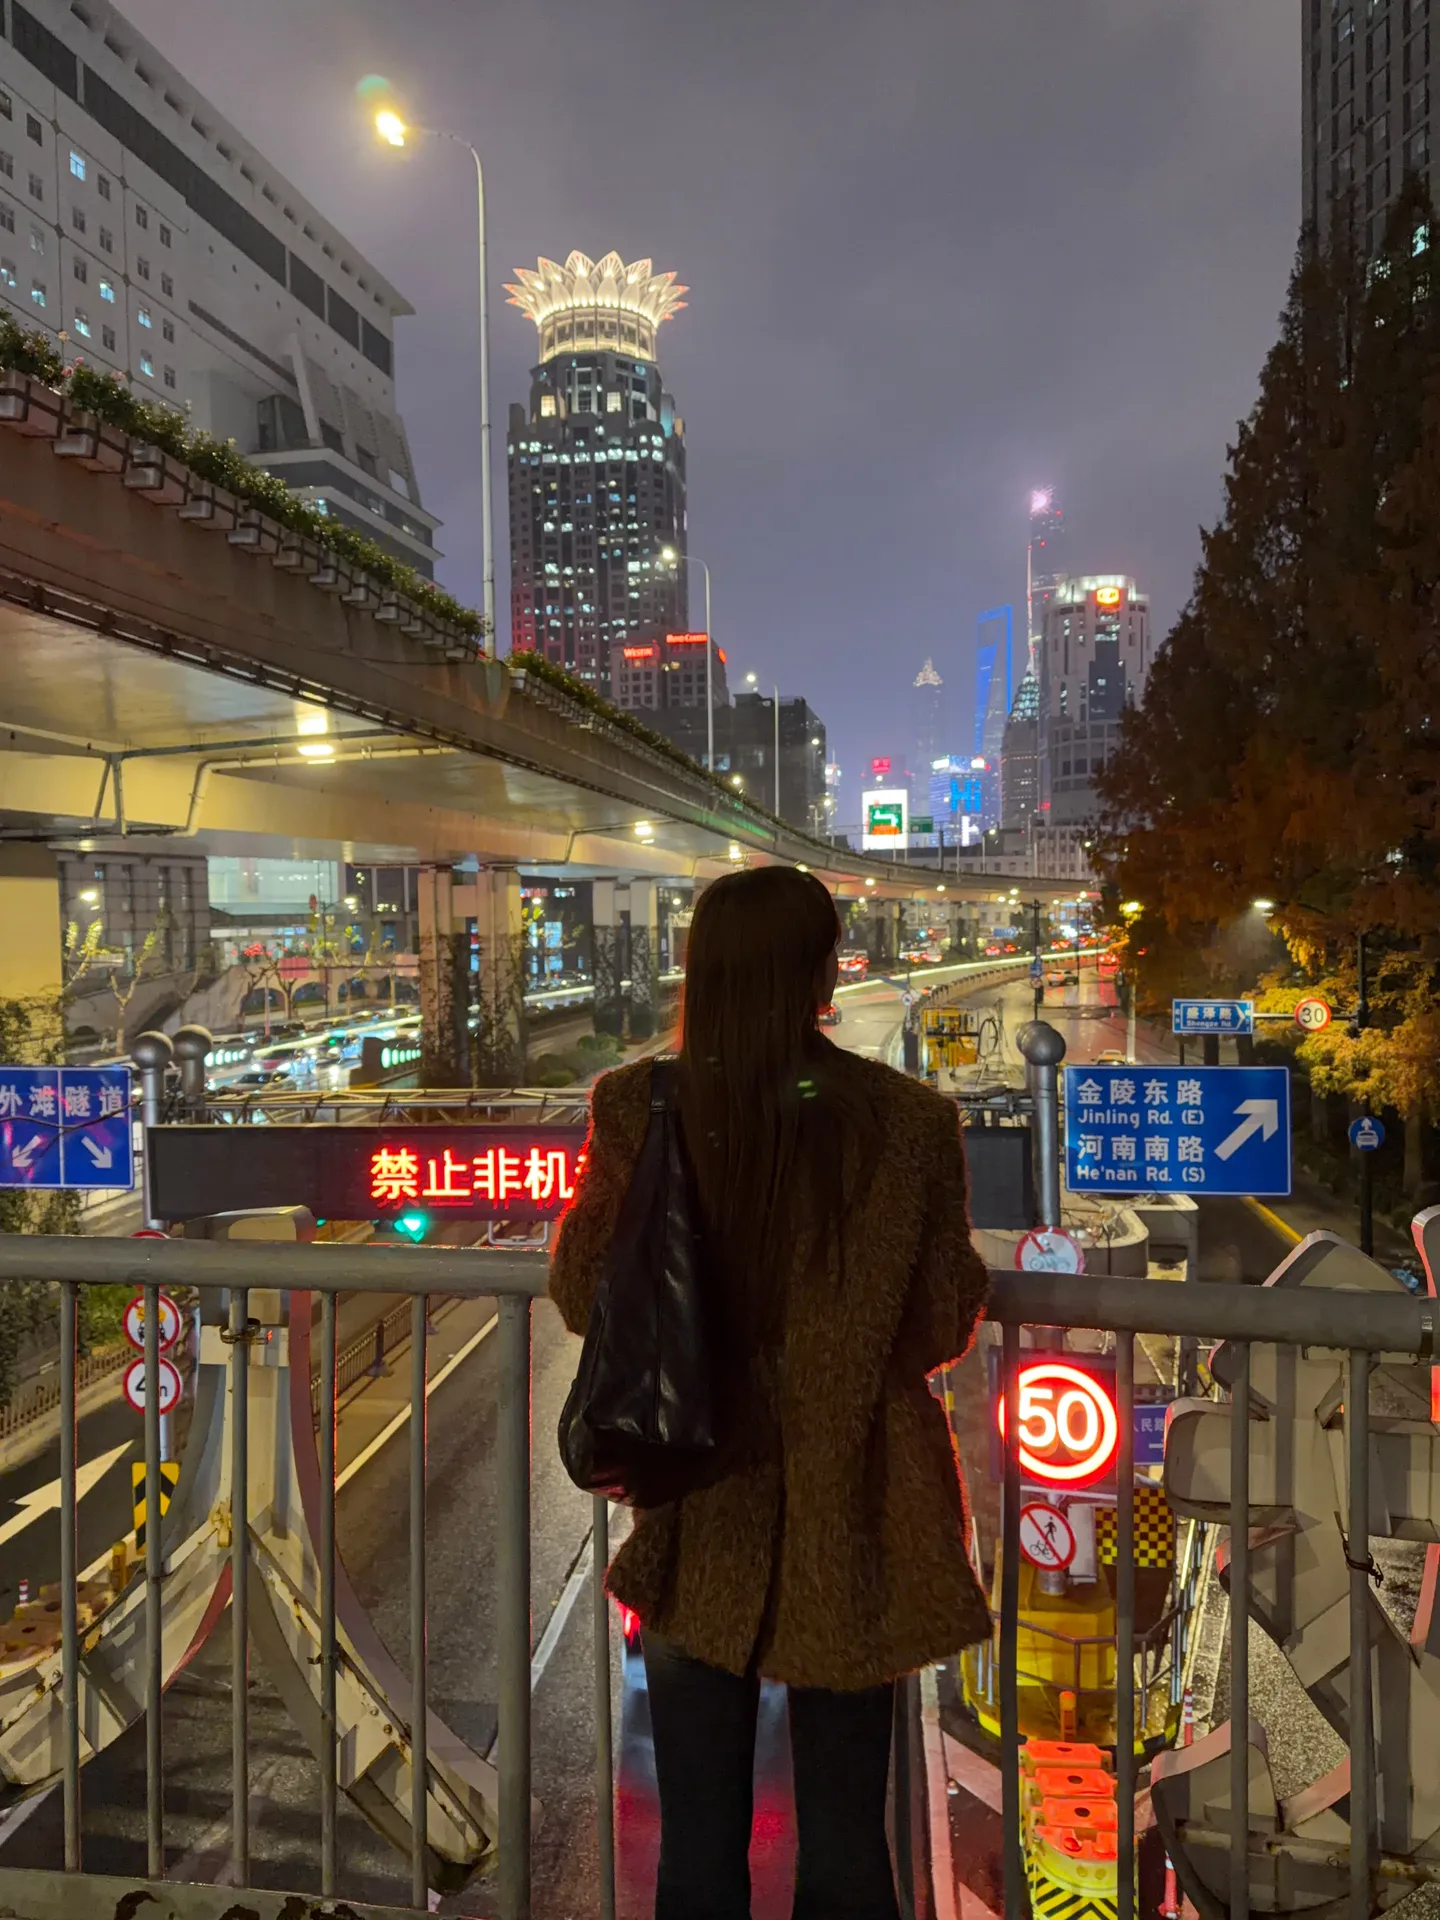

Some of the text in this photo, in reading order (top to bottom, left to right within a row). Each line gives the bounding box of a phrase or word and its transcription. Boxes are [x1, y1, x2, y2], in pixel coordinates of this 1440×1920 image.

[951, 779, 981, 812] Hi
[1302, 1007, 1324, 1024] 30
[0, 1085, 125, 1118] 外滩隧道
[1077, 1078, 1203, 1106] 金陵东路
[1078, 1108, 1205, 1129] Jinling Rd. (E)
[1077, 1134, 1205, 1163] 河南南路
[370, 1148, 588, 1200] 禁止非机
[1076, 1165, 1205, 1182] He'nan Rd. (S)
[1018, 1386, 1099, 1451] 50
